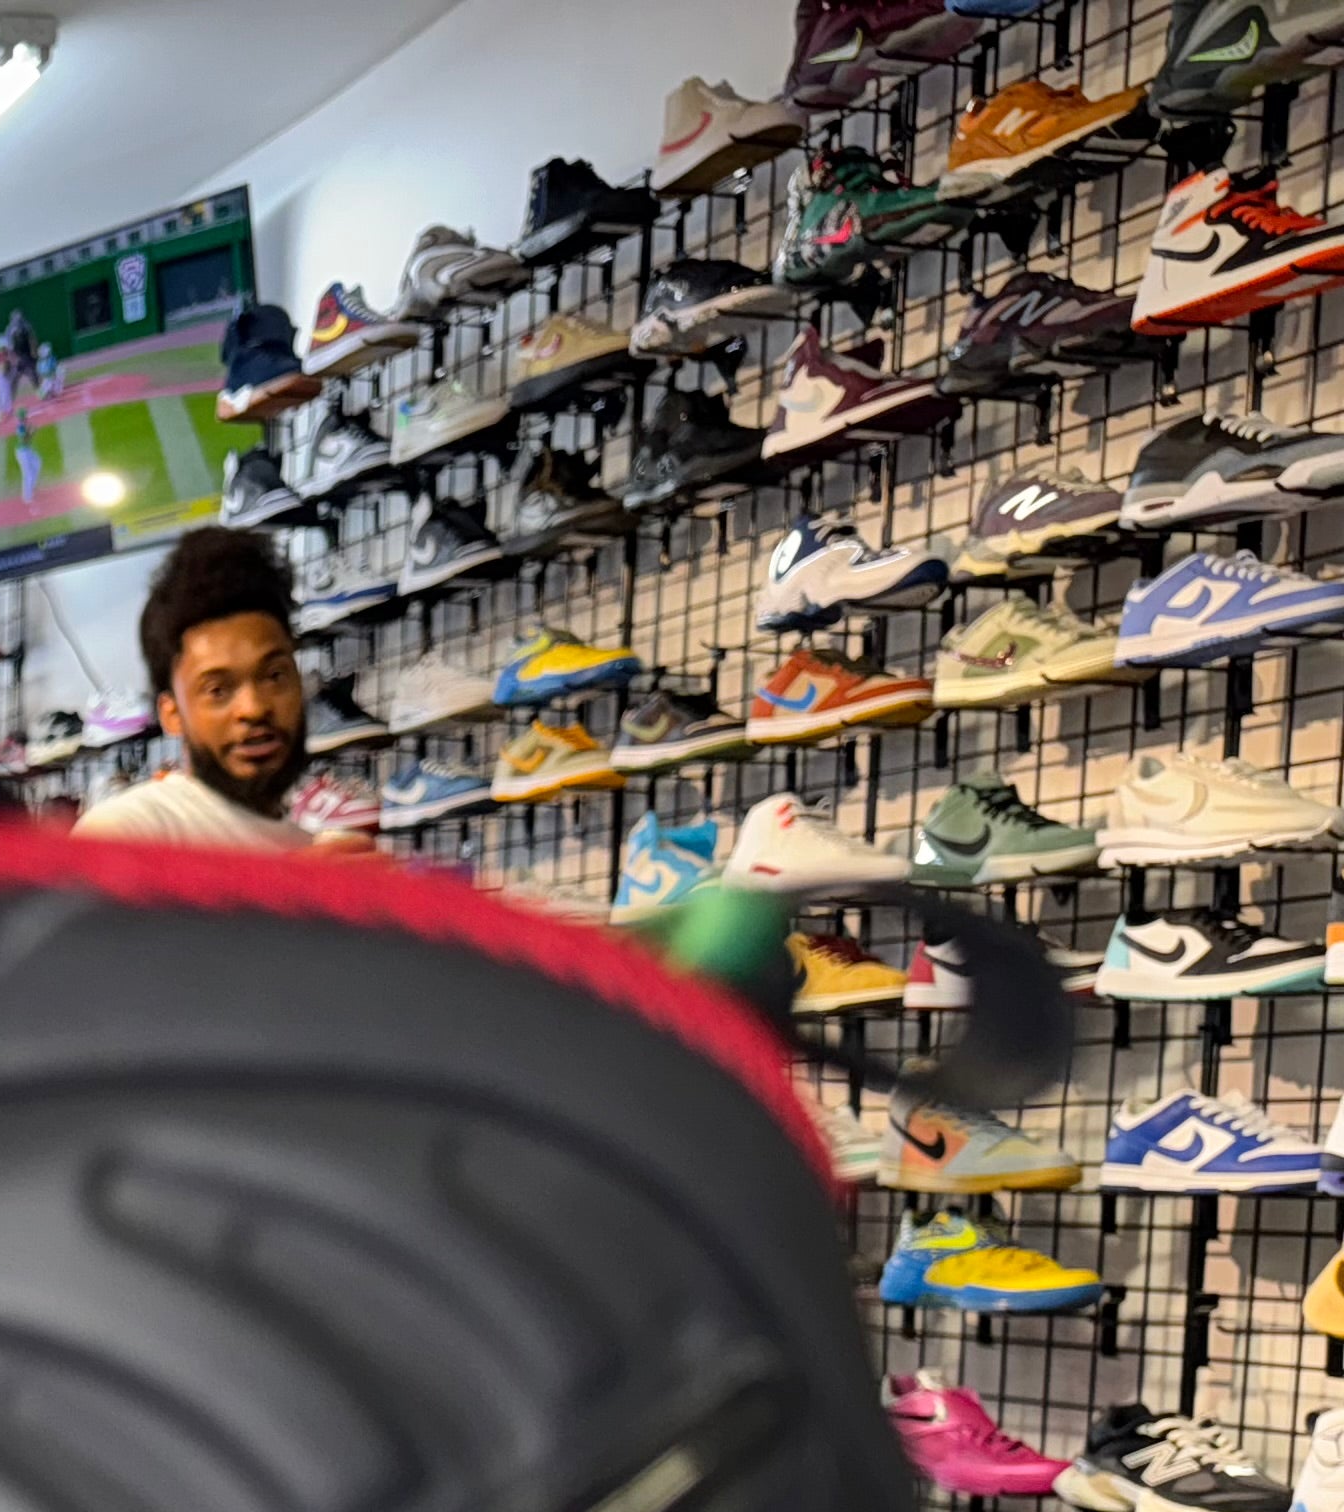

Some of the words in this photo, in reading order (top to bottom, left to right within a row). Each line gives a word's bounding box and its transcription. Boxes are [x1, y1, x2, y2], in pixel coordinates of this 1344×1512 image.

[999, 290, 1062, 327] N
[998, 484, 1059, 521] N
[1121, 1439, 1201, 1488] N
